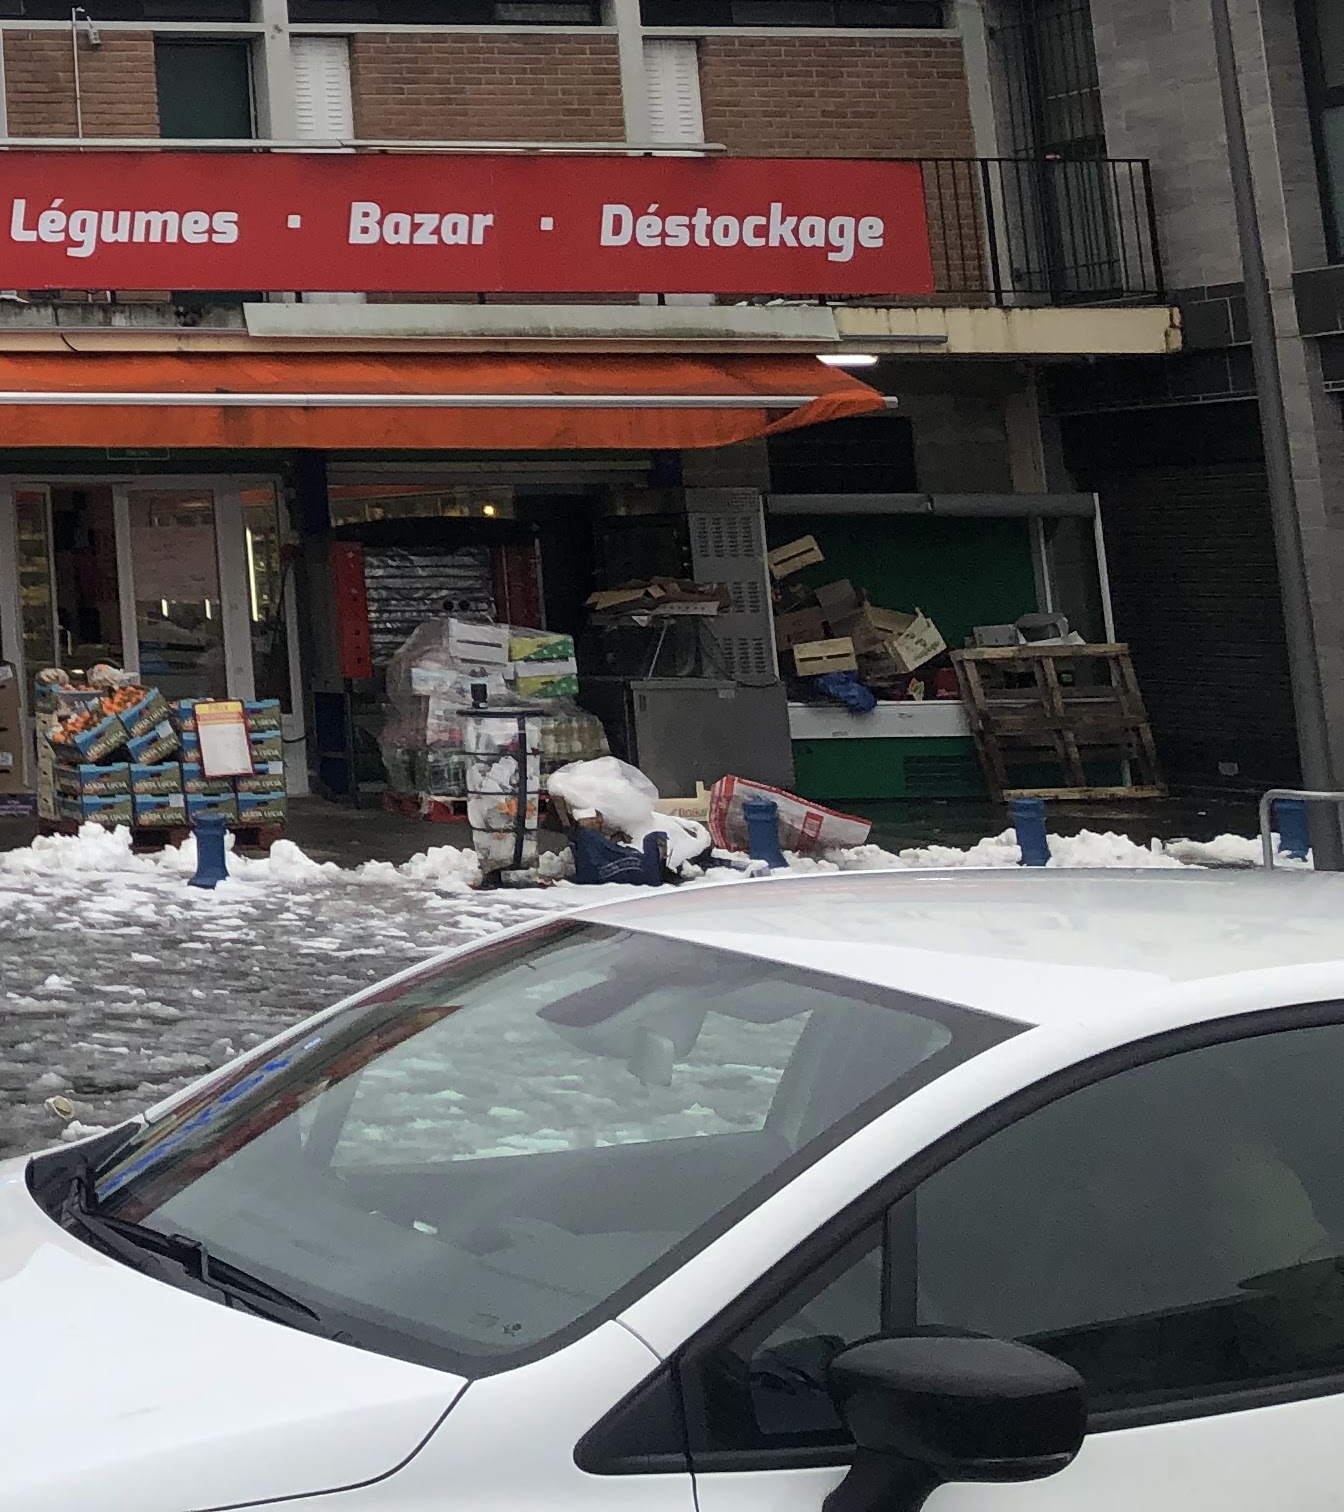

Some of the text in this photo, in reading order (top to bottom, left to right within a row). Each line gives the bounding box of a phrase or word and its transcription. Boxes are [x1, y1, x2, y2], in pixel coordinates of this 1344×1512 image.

[10, 198, 885, 262] Légumes Bazar Déstockage
